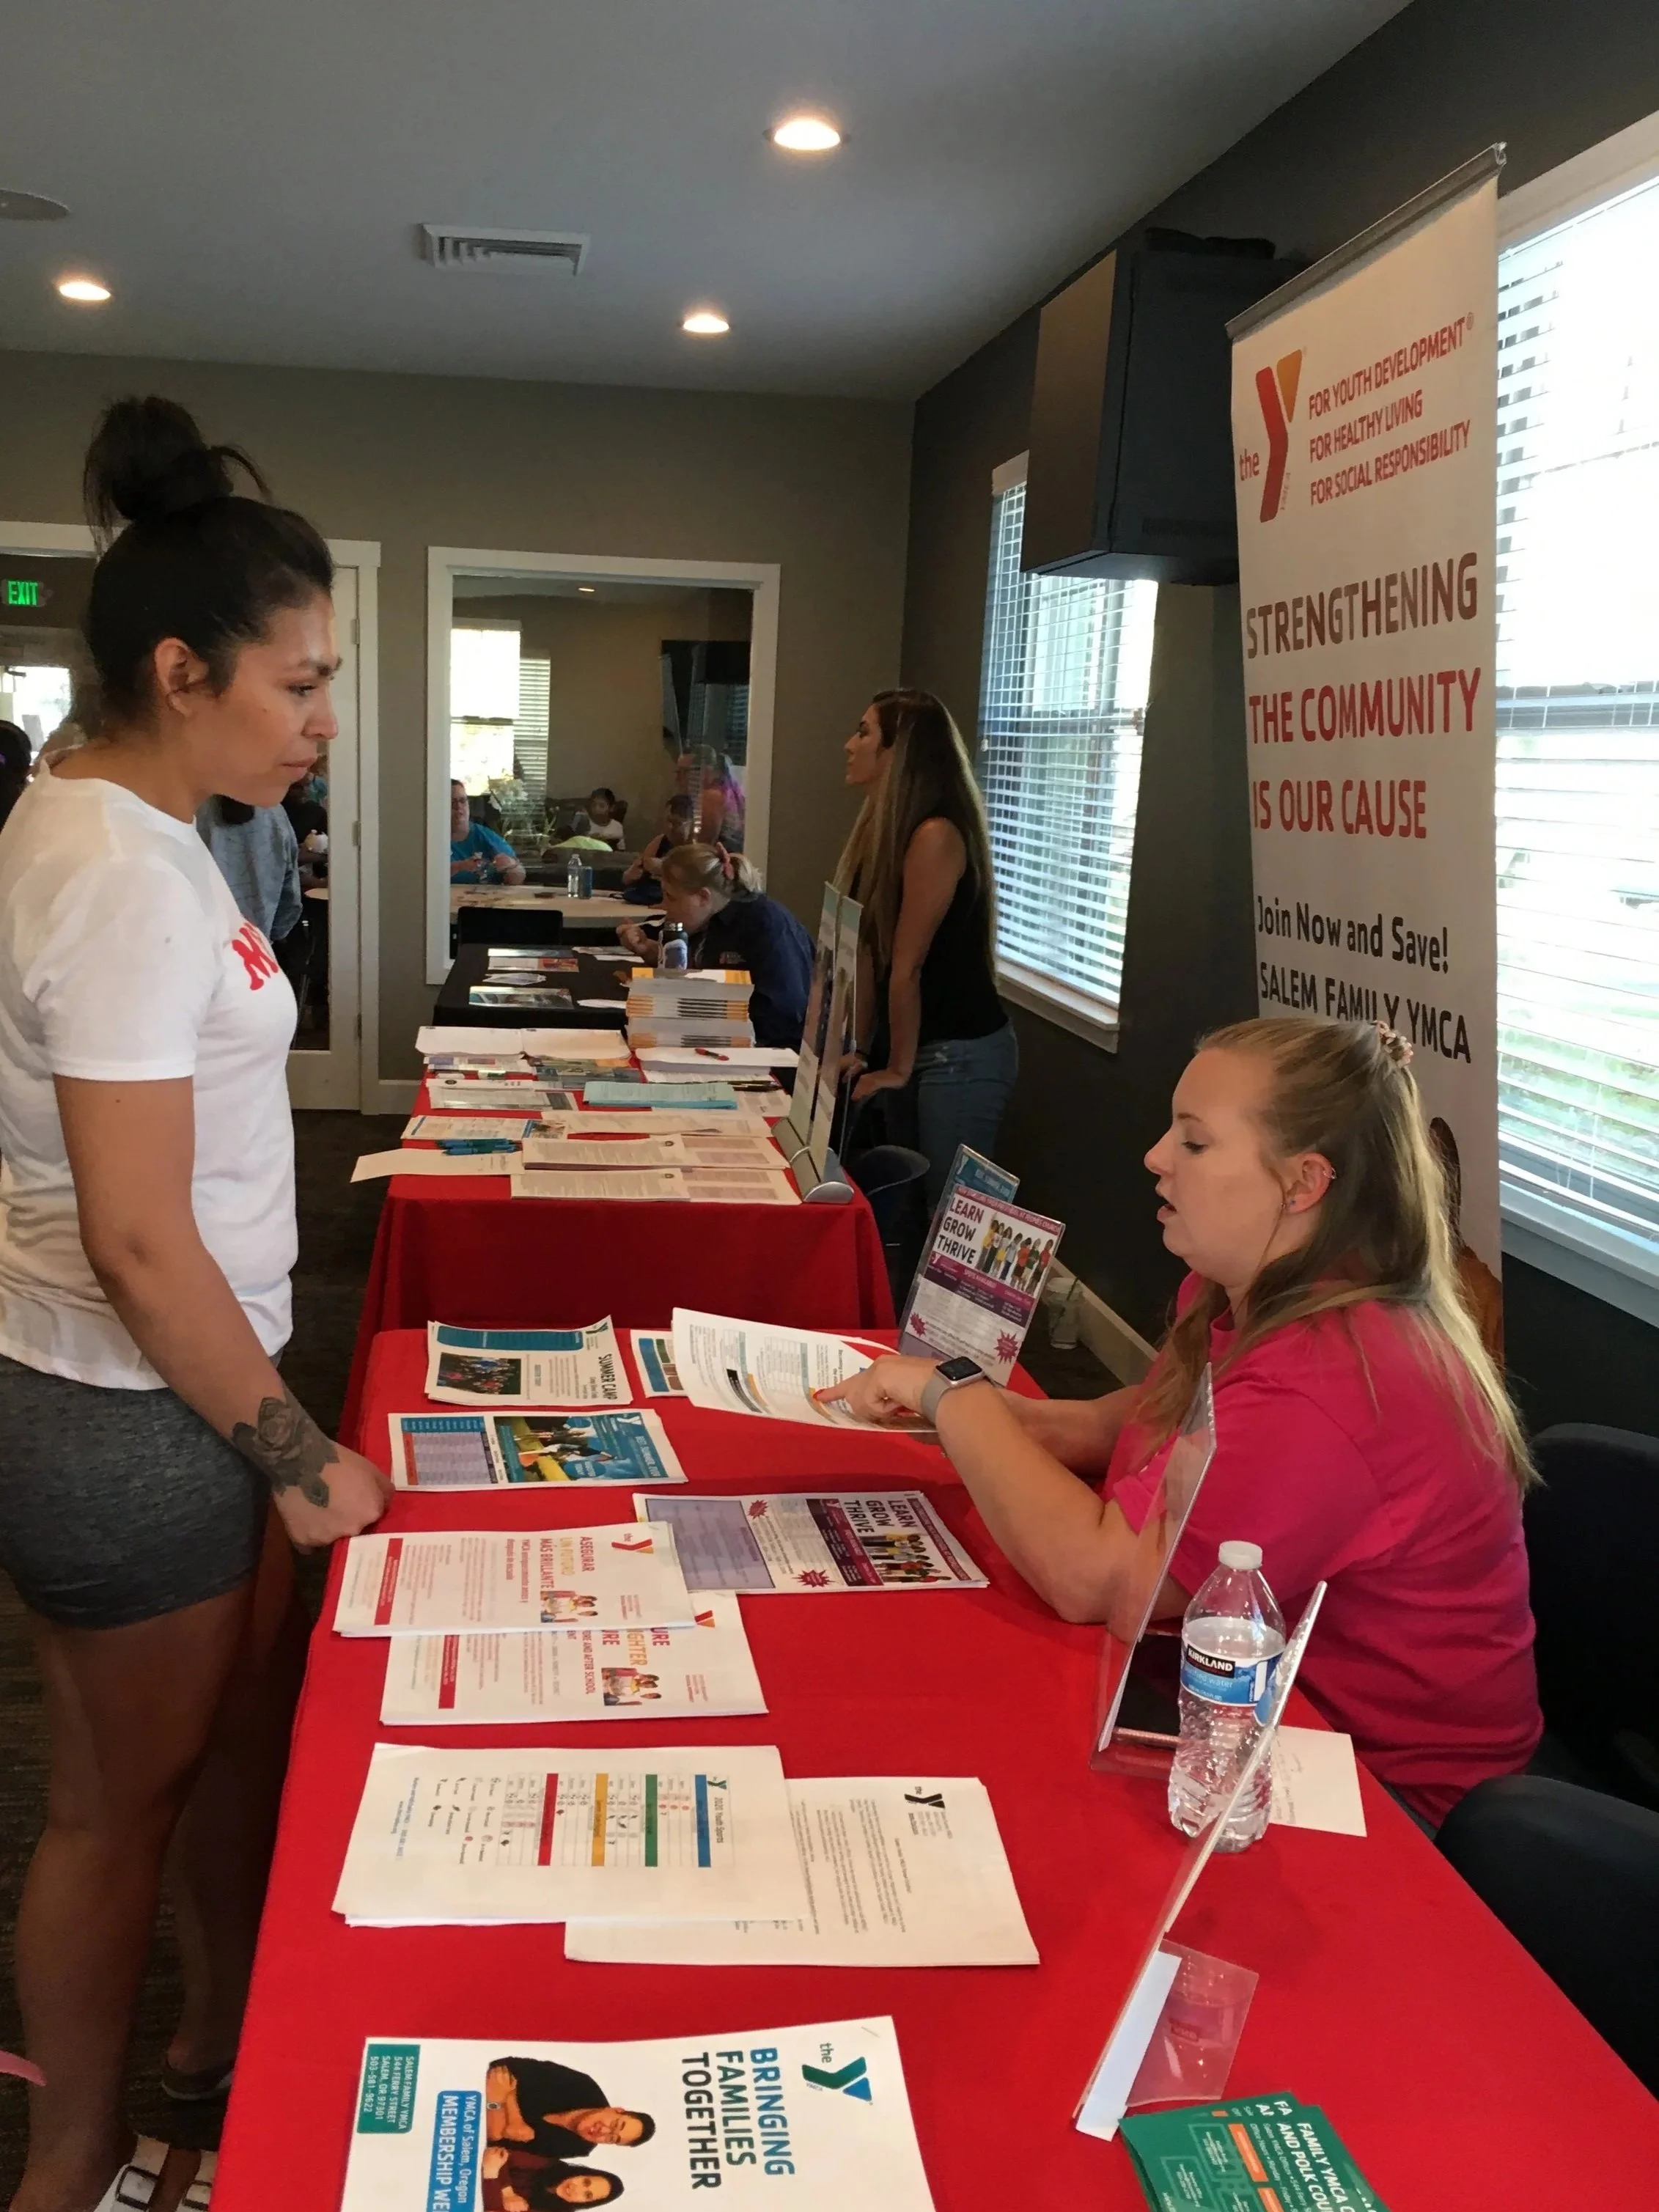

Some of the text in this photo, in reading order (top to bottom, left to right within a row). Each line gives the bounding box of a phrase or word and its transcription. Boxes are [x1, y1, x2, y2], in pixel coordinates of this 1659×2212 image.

[1309, 389, 1331, 419] FOR
[1333, 367, 1372, 407] YOUTH
[1310, 389, 1422, 463] FOR HEALTHY LIVING
[1239, 449, 1259, 481] the
[1311, 477, 1332, 507] FOR
[1335, 461, 1372, 498] SOCIAL
[1375, 419, 1470, 483] RESPONSIBILITY
[8, 581, 38, 606] EXIT
[1246, 552, 1477, 659] STRENGTHENING
[1249, 667, 1481, 743] THE COMMUNITY
[1253, 779, 1427, 839] IS OUR CAUSE
[1258, 895, 1449, 974] Join Now and Save!
[1260, 962, 1318, 1013] SALEM
[1407, 999, 1471, 1064] YMCA
[950, 1197, 984, 1224] LEARN
[943, 1216, 976, 1241] GROW
[937, 1235, 976, 1264] THRIVE
[598, 1353, 617, 1400] SUMMER CAMP
[844, 1500, 875, 1533] THRIVE
[865, 1500, 895, 1526] GROW
[887, 1500, 919, 1527] LEARN
[580, 1537, 595, 1572] ASEGURAR
[623, 1533, 633, 1542] the
[540, 1554, 555, 1589] BRILLANTE
[583, 1642, 592, 1653] AND
[584, 1654, 594, 1670] AFTER
[1188, 1648, 1233, 1672] KIRKLAND
[584, 1672, 595, 1694] SCHOOL
[1209, 1677, 1232, 1688] water
[819, 2043, 833, 2064] the
[378, 2083, 387, 2095] OR
[387, 2056, 402, 2124] 544 FERRY STREET
[398, 2056, 414, 2129] SALEM FAMILY YMCA
[375, 2096, 386, 2120] 97301
[682, 2051, 722, 2190] TOGETHER
[716, 2050, 757, 2167] FAMILIES
[750, 2047, 795, 2176] BRINGING
[435, 2095, 459, 2186] MEMBERSHIP
[455, 2095, 477, 2204] YMCA of Salem, Oregon
[1276, 2123, 1301, 2149] AND
[1291, 2149, 1319, 2183] POLK
[1297, 2123, 1349, 2204] FAMILY YMCA
